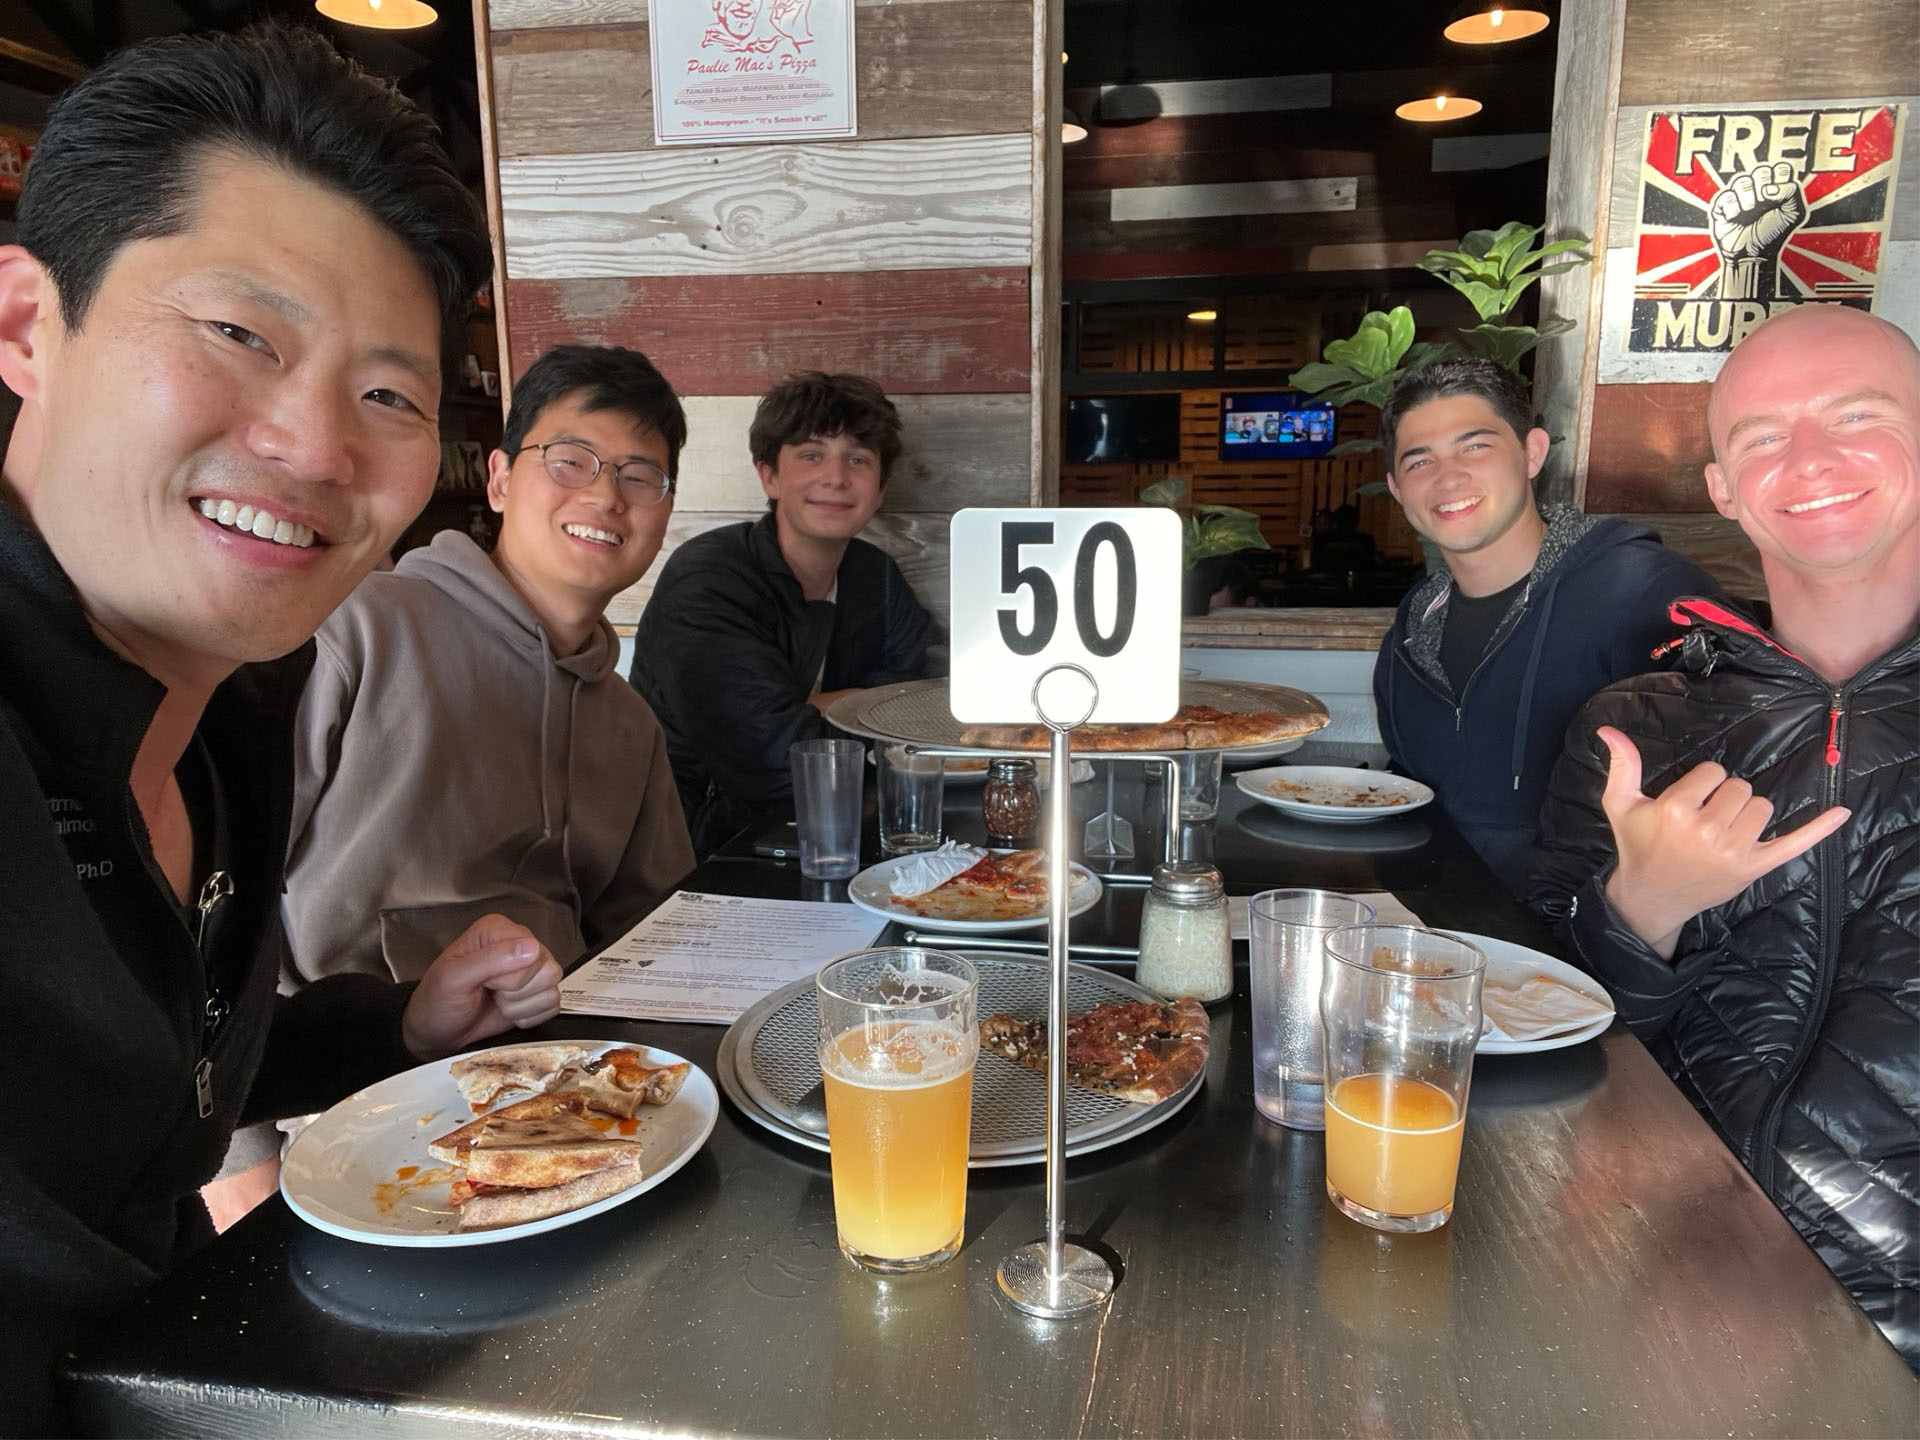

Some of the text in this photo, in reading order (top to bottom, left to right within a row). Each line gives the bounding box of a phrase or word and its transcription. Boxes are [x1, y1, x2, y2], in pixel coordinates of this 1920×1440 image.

[687, 53, 818, 75] Paulie Mac's Pizza
[703, 118, 749, 127] Homegrown
[1674, 110, 1863, 176] FREE
[1652, 301, 1842, 348] MUR
[996, 520, 1137, 658] 50
[76, 860, 113, 880] PhD
